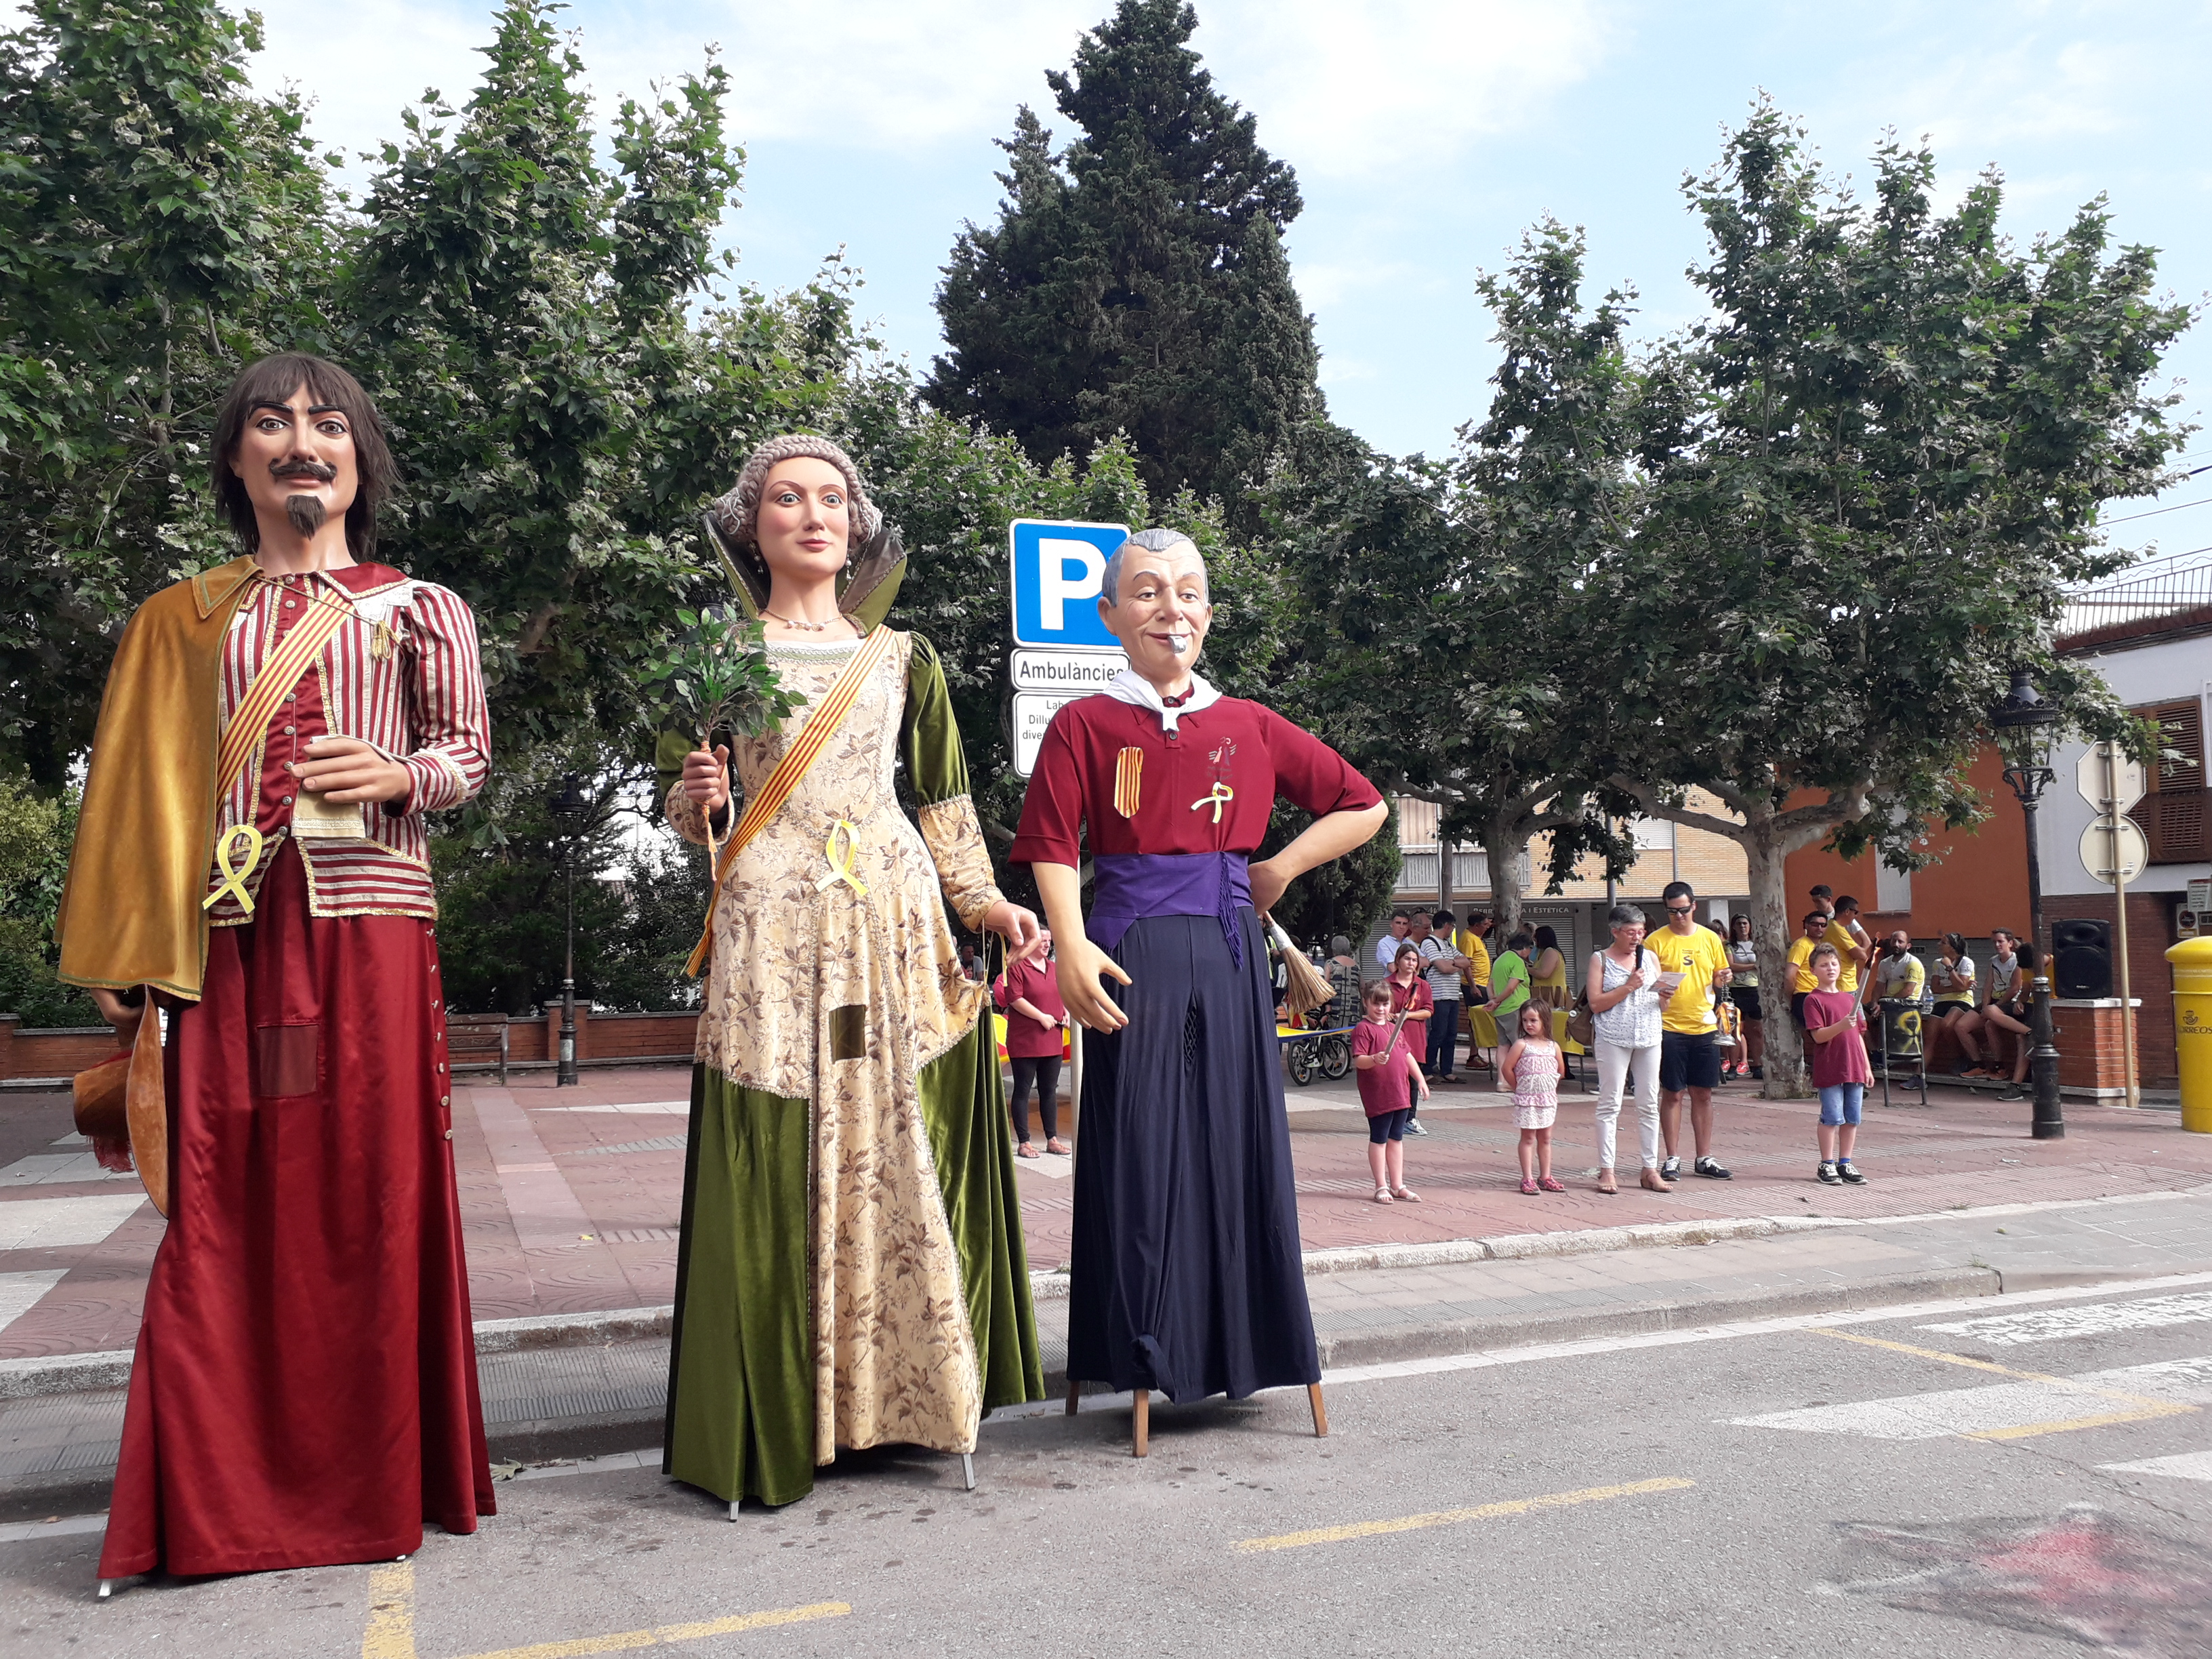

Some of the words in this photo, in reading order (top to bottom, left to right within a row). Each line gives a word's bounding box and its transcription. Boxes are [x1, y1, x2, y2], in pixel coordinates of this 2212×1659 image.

[1039, 537, 1107, 630] P
[1046, 700, 1064, 710] Lab
[1029, 714, 1050, 724] Dillu
[1022, 730, 1045, 739] dive
